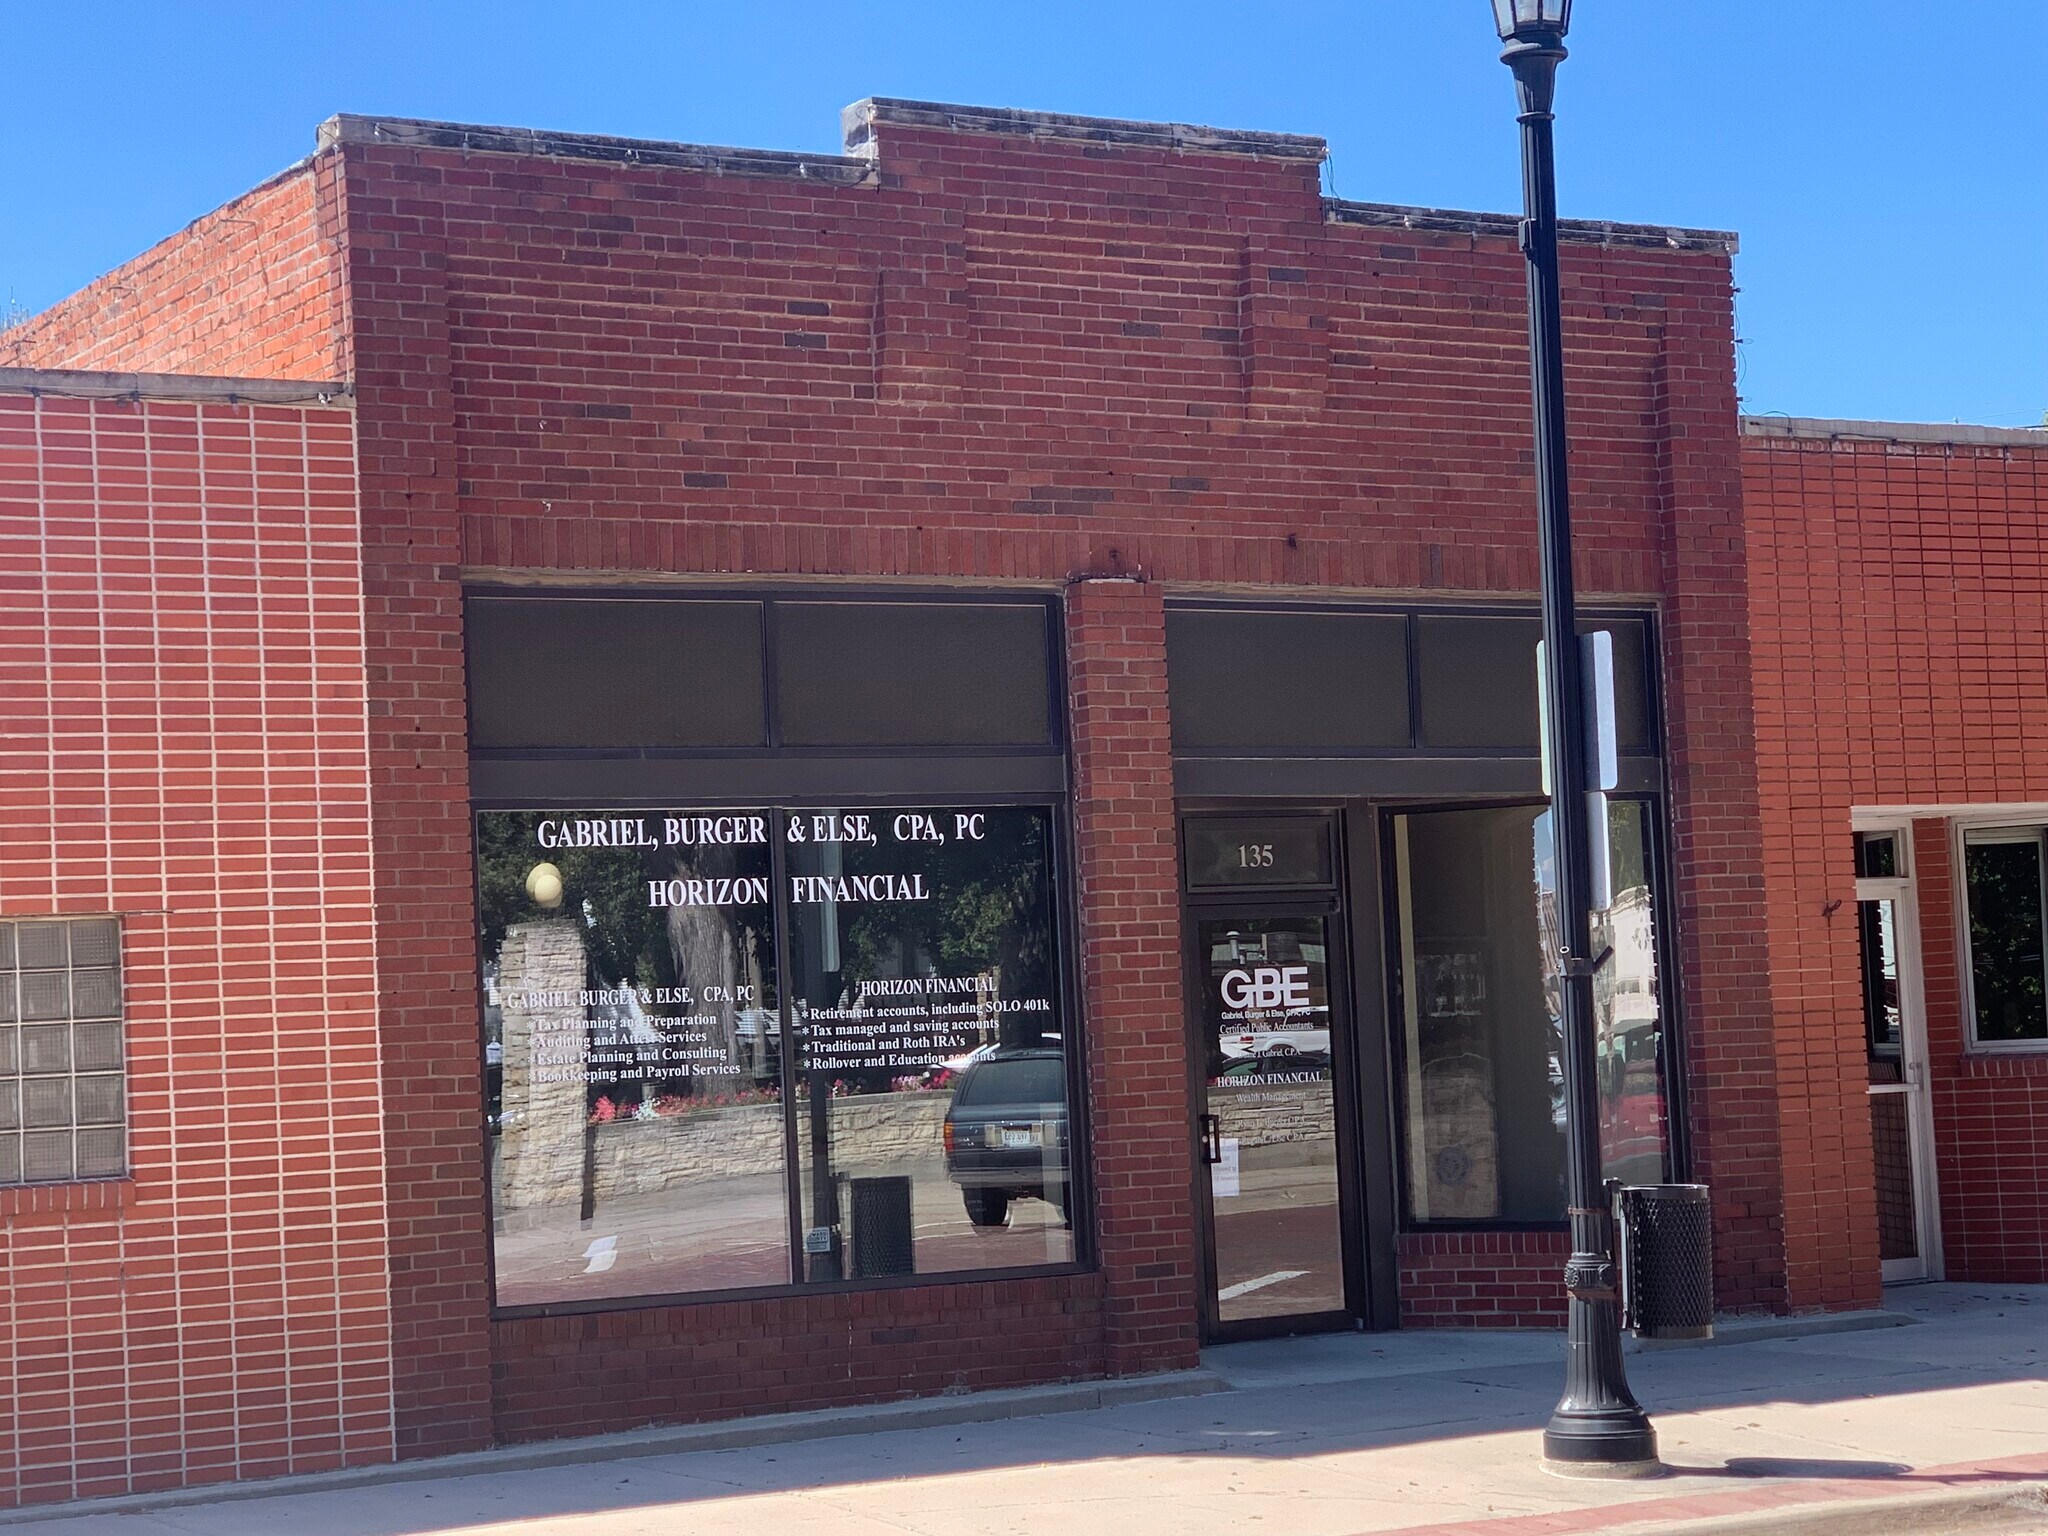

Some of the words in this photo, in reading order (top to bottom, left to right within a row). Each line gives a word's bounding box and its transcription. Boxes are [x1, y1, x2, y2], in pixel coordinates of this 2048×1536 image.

[537, 818, 658, 851] GABRIEL,
[663, 817, 767, 845] BURGER
[787, 815, 806, 843] &
[812, 815, 877, 847] ELSE,
[894, 814, 945, 846] CPA,
[955, 813, 985, 840] PC
[1238, 844, 1274, 868] 135
[648, 877, 768, 908] HORIZON
[791, 874, 929, 903] FINANCIAL
[580, 988, 638, 1007] BURGER
[640, 988, 653, 1004] &
[655, 987, 695, 1006] ELSE,
[704, 986, 734, 1003] CPA,
[737, 985, 755, 1001] PC
[861, 979, 923, 996] HORIZON
[926, 976, 997, 994] FINANCIAL
[1221, 966, 1310, 1009] GBE
[810, 1006, 875, 1020] Retirement
[877, 1004, 929, 1018] accounts,
[931, 1001, 983, 1016] including
[986, 1000, 1021, 1013] SOLO
[1023, 999, 1050, 1011] 401k
[536, 1017, 560, 1031] Tax
[563, 1015, 616, 1032] Planning
[646, 1013, 717, 1030] Preparation
[811, 1024, 832, 1036] Tax
[835, 1022, 886, 1037] managed
[889, 1020, 911, 1033] and
[913, 1019, 949, 1034] saving
[951, 1018, 1000, 1030] accounts
[537, 1033, 590, 1049] Auditing
[594, 1033, 617, 1046] and
[658, 1030, 707, 1043] Services
[811, 1038, 876, 1053] Traditional
[878, 1037, 900, 1050] and
[903, 1036, 930, 1049] Roth
[933, 1034, 966, 1047] IRA's
[537, 1050, 576, 1065] Estate
[579, 1049, 634, 1066] Planning
[636, 1048, 659, 1062] and
[662, 1046, 727, 1061] Consulting
[812, 1056, 862, 1070] Rollover
[864, 1054, 886, 1067] and
[888, 1052, 945, 1066] Education
[538, 1066, 618, 1083] Bookkeeping
[620, 1065, 643, 1079] and
[646, 1063, 689, 1080] Payroll
[692, 1062, 741, 1077] Services
[1217, 1074, 1265, 1088] HORIZON
[1266, 1071, 1324, 1085] FINANCIAL
